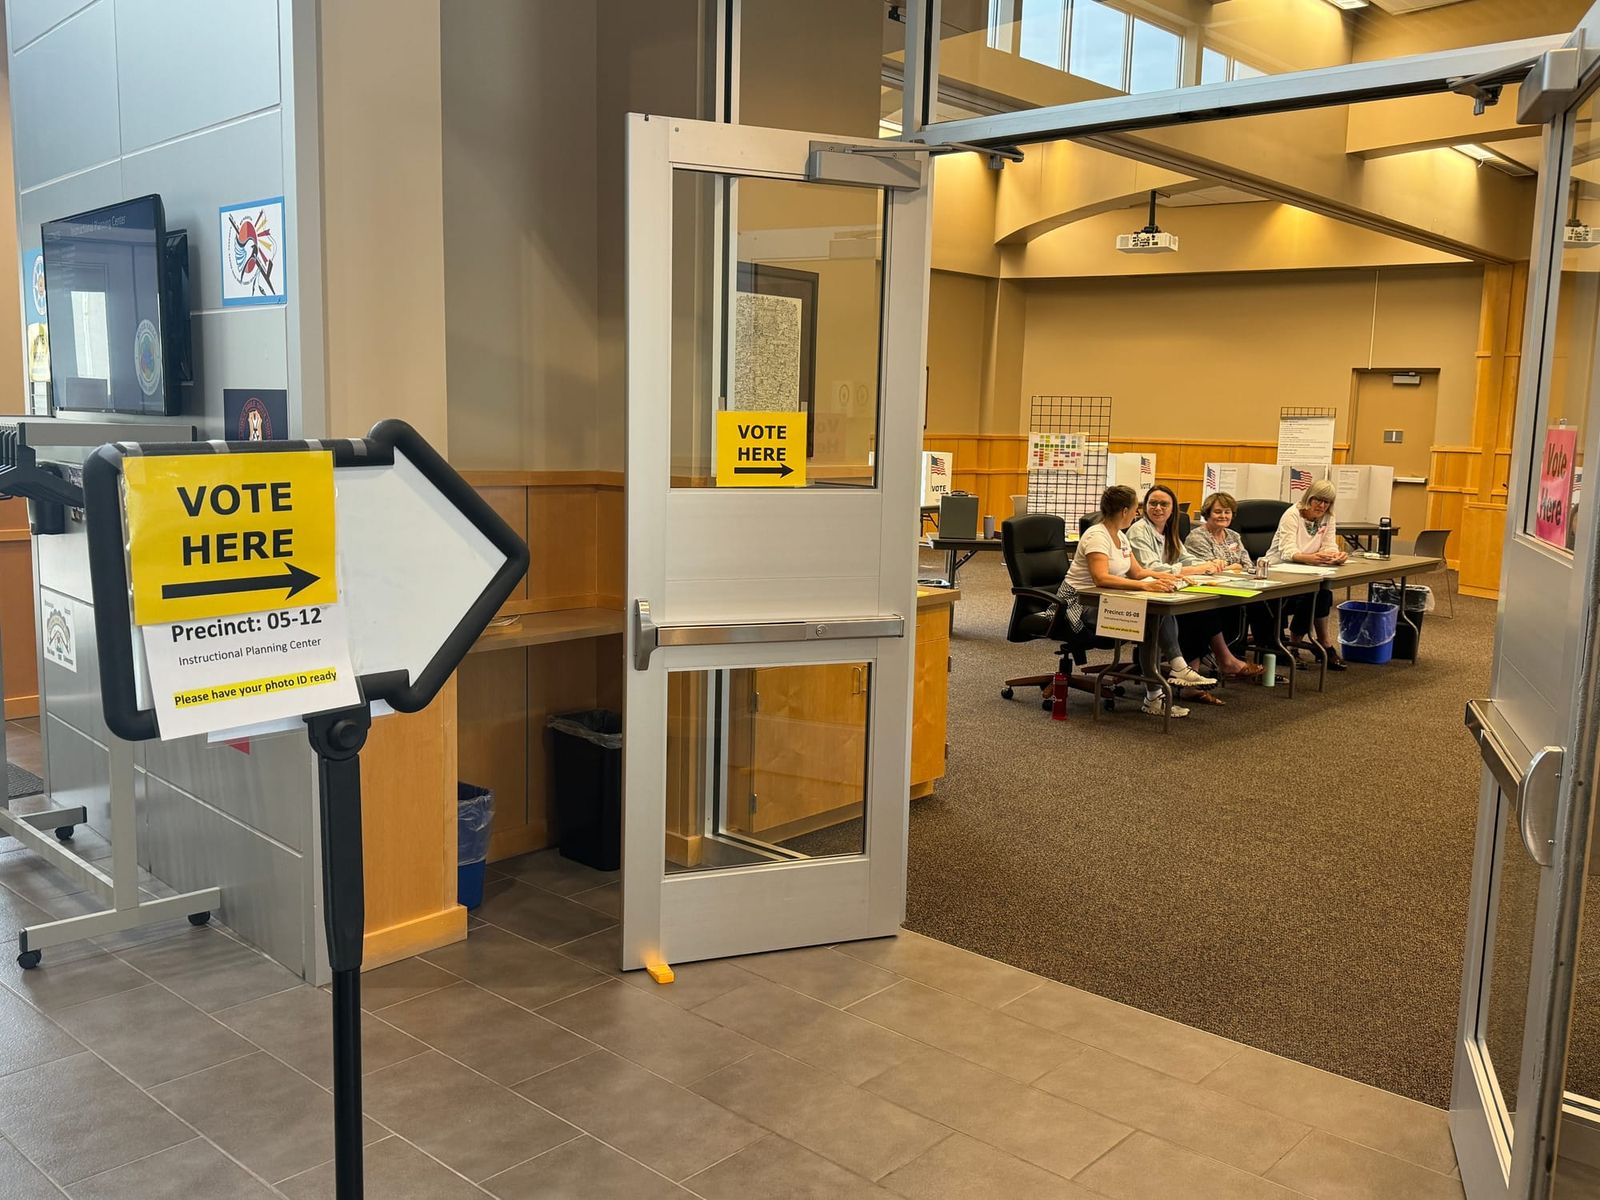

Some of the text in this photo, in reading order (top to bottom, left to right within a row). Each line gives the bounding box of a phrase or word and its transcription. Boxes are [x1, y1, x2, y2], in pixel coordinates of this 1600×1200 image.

[737, 425, 787, 440] VOTE
[738, 447, 786, 462] HERE
[1546, 443, 1568, 479] Vote
[176, 482, 293, 517] VOTE
[1538, 488, 1563, 526] Here
[182, 528, 294, 566] HERE
[171, 607, 322, 643] Precinct: 05-12
[178, 638, 322, 667] Instructional Planning Center
[174, 670, 337, 706] Please have your photo ID ready
